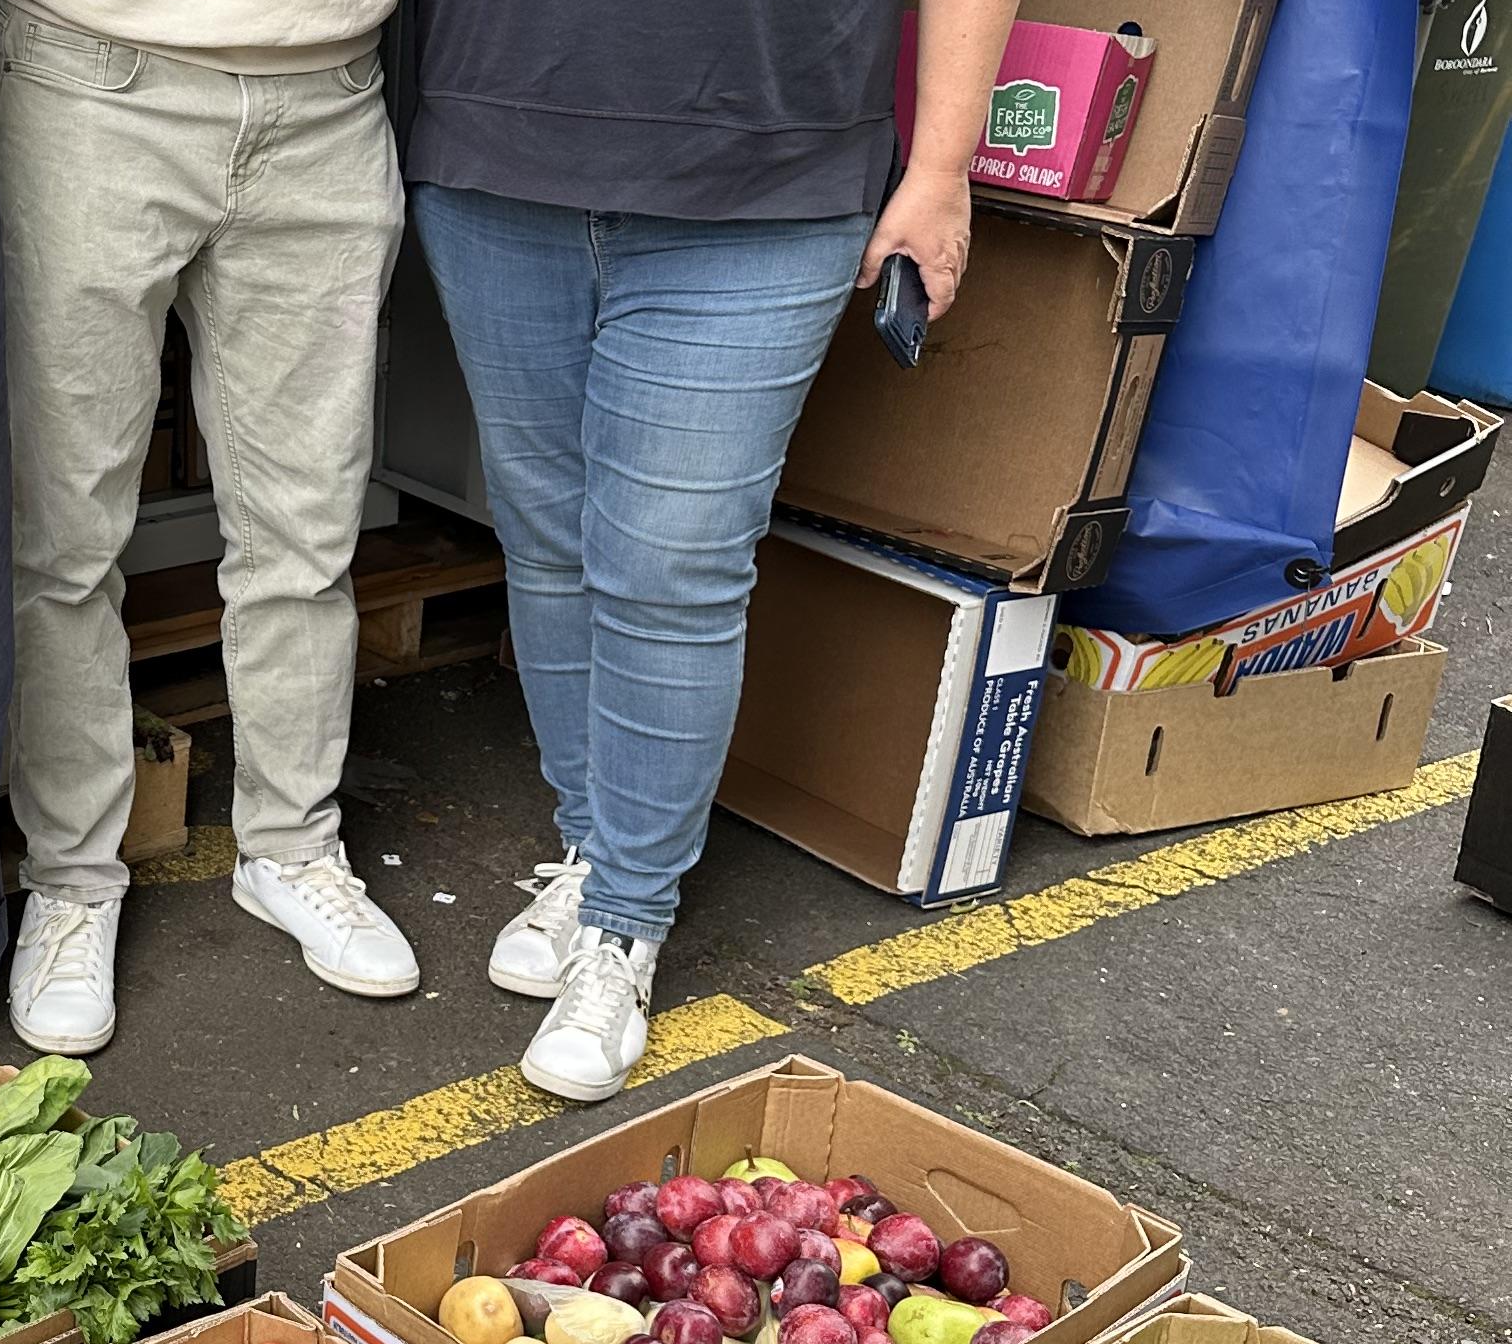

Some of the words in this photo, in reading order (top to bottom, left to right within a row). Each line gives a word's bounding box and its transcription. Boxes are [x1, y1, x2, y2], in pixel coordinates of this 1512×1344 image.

[994, 125, 1031, 138] SALAD
[996, 107, 1046, 126] FRESH
[970, 155, 1016, 179] EPARED
[1018, 164, 1064, 189] SALADS
[1241, 569, 1380, 645] BANANAS
[974, 679, 995, 736] PRODUCE
[1003, 693, 1022, 736] Table
[1018, 680, 1039, 722] Fresh
[972, 736, 983, 755] OF
[1002, 725, 1030, 804] Australian
[958, 756, 978, 819] AUSTRALIA
[990, 739, 1012, 796] Grapes
